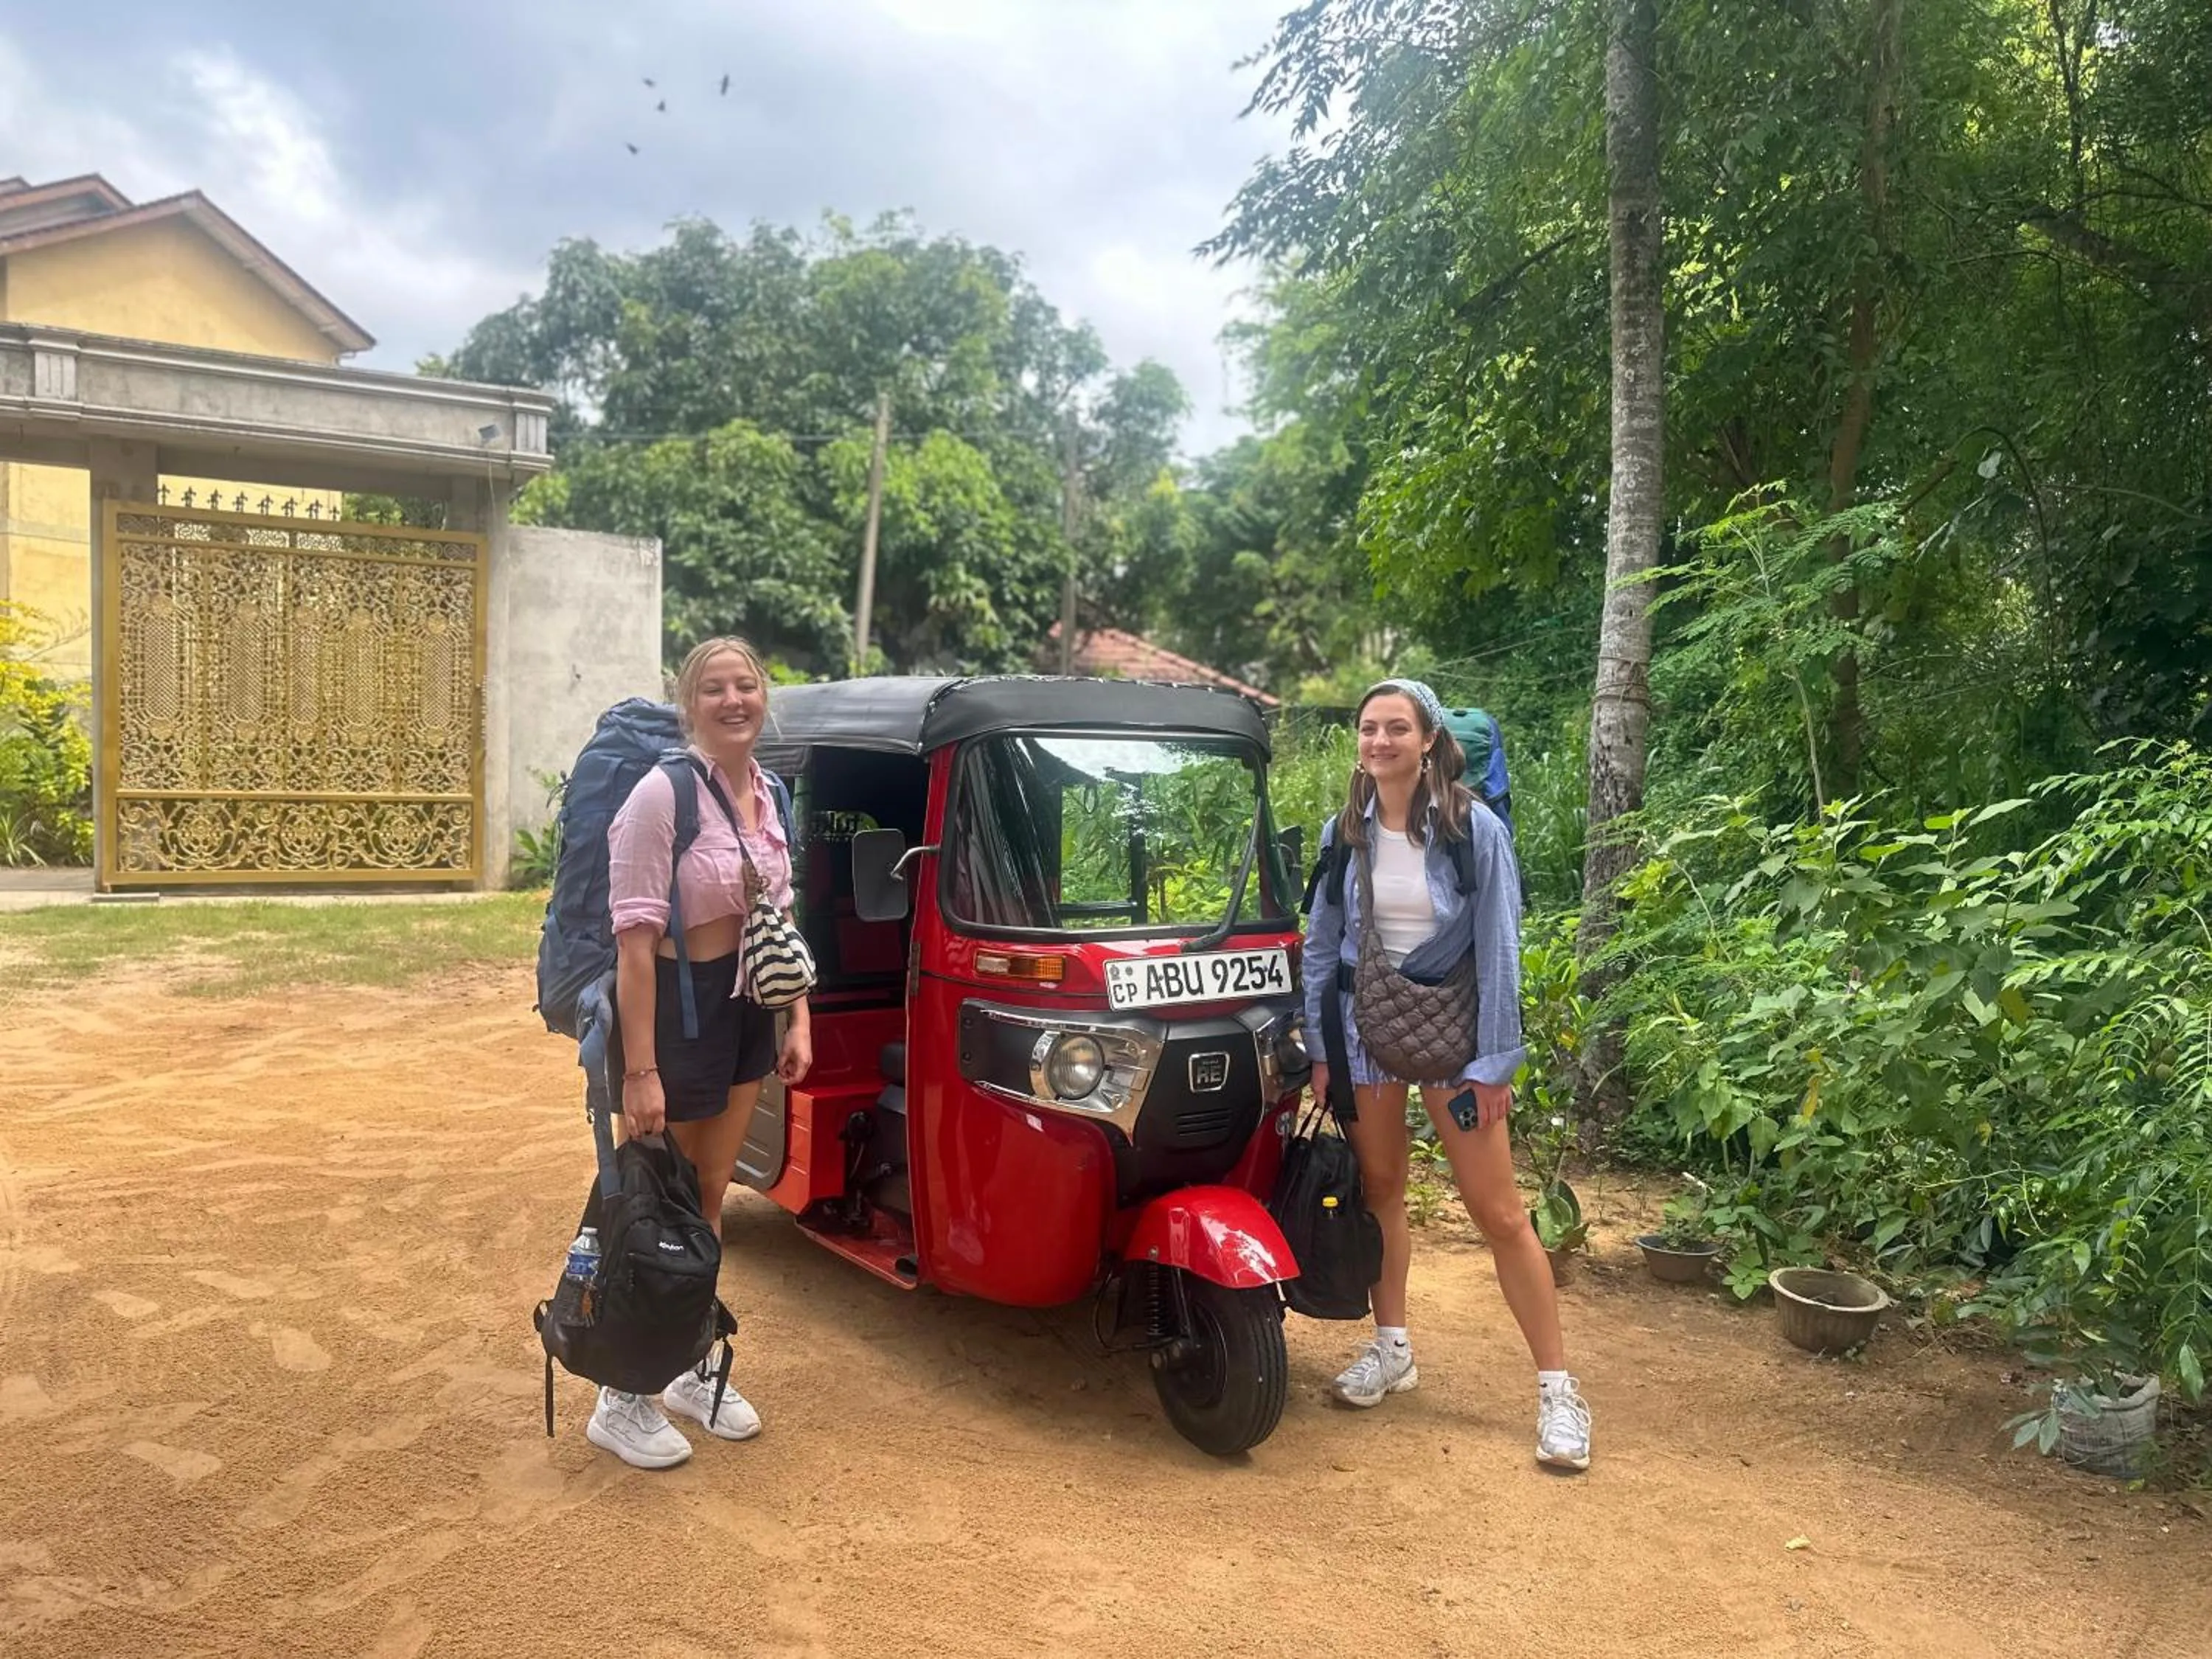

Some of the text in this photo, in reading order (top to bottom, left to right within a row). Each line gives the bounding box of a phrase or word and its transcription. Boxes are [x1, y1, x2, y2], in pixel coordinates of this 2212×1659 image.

[1147, 954, 1283, 1000] ABU 9254
[1112, 983, 1138, 1003] CP
[1197, 1065, 1222, 1084] RE
